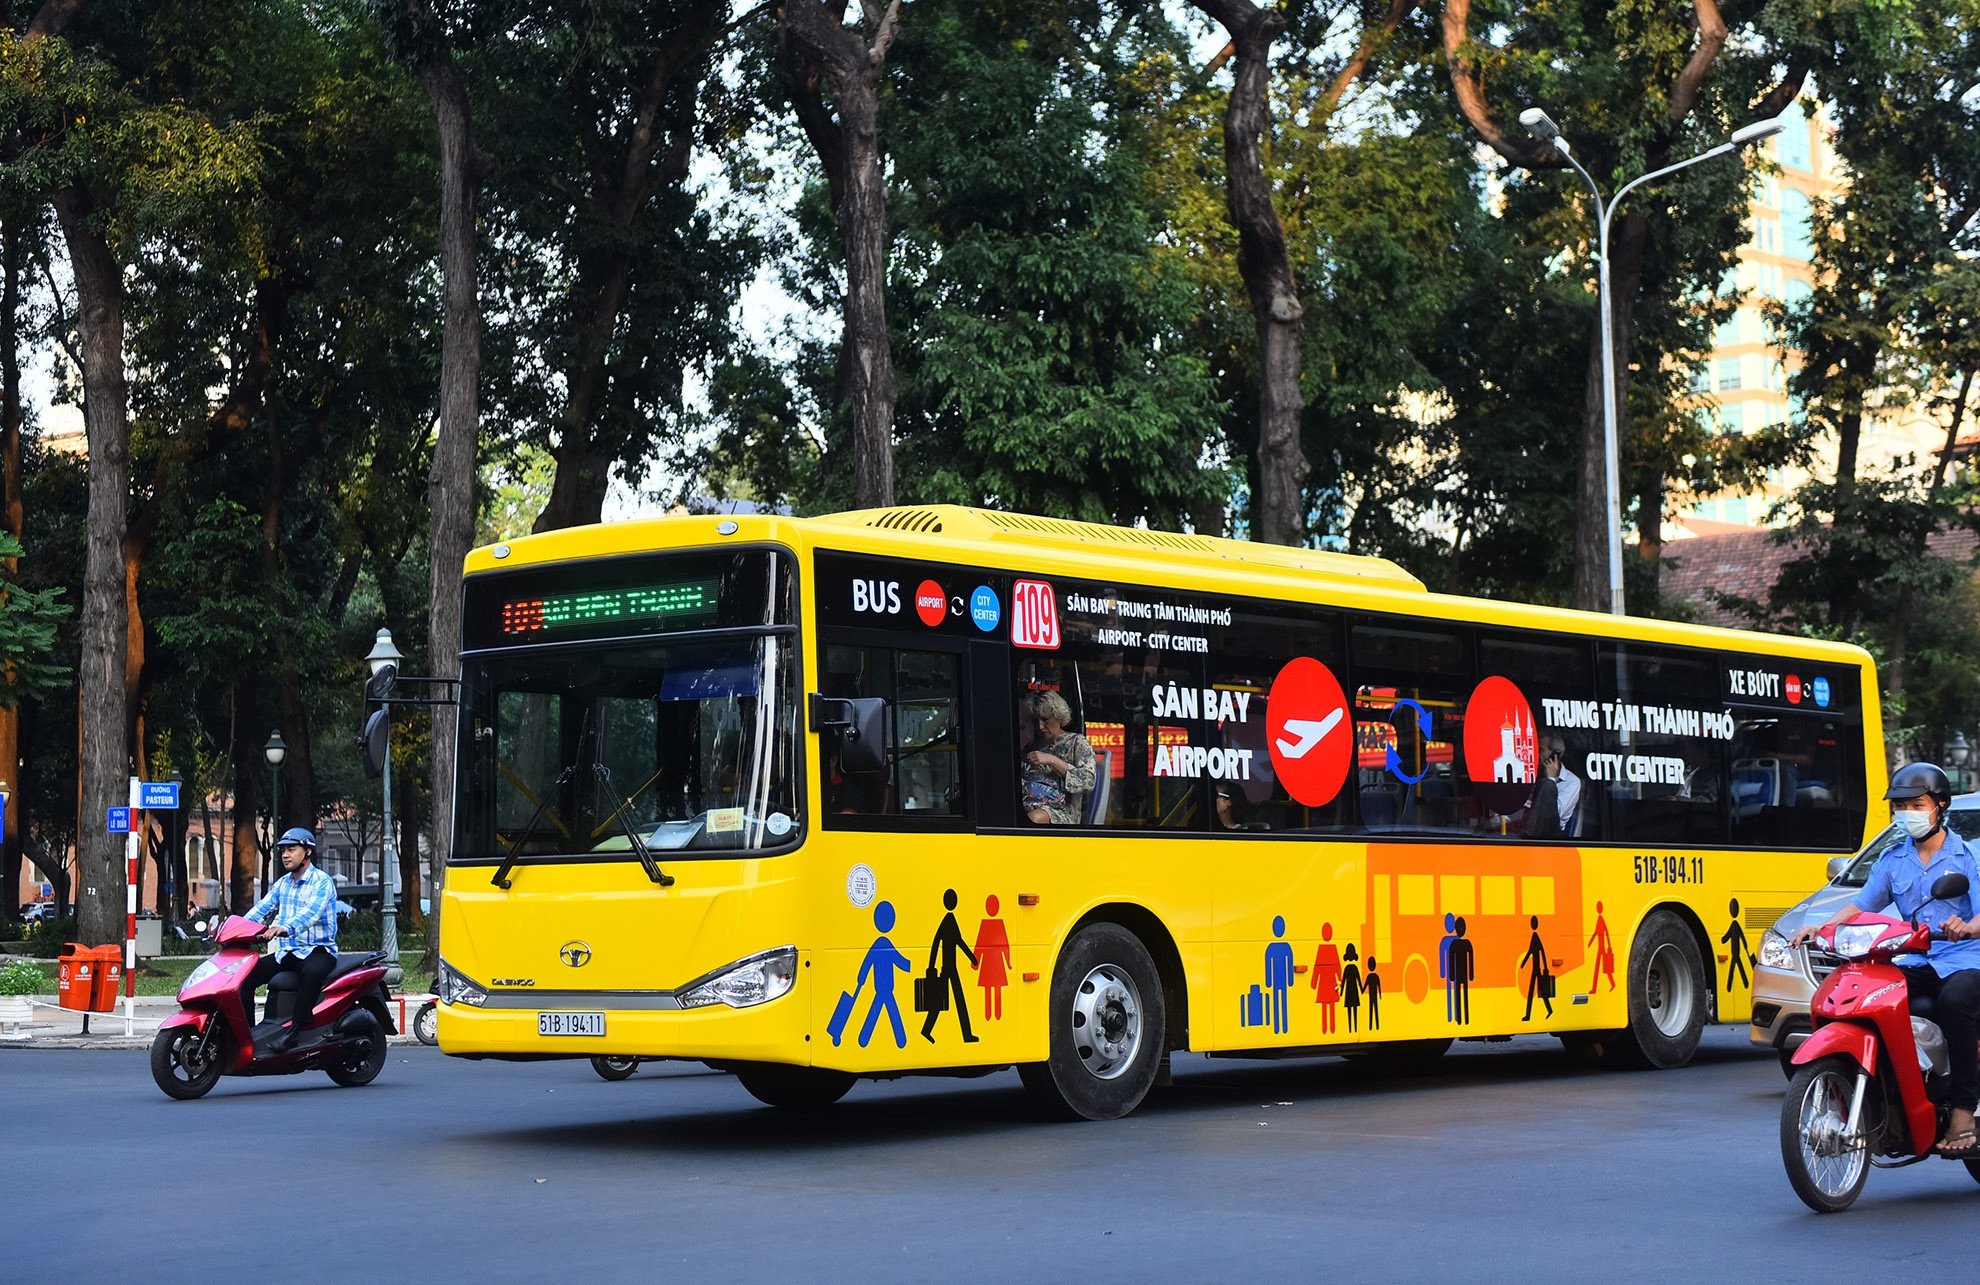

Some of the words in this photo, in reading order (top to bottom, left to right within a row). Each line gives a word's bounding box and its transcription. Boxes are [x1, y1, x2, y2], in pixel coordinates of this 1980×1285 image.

[852, 579, 901, 614] BUS
[918, 596, 944, 609] AIRPORT
[977, 595, 991, 607] CITY
[1066, 593, 1089, 613] SÂN
[1090, 597, 1110, 615] BAY
[1116, 600, 1151, 619] TRUNG
[1153, 602, 1175, 621] TÂM
[1175, 604, 1210, 624] THÀNH
[1211, 607, 1232, 627] PHỐ
[973, 608, 998, 622] CENTER
[1016, 584, 1051, 644] 109
[1098, 628, 1142, 648] AIRPORT
[1149, 633, 1171, 650] CITY
[1172, 635, 1209, 653] CENTER
[1729, 669, 1746, 695] XE
[1747, 669, 1780, 698] BÚYT
[1152, 680, 1198, 720] SÂN
[1203, 689, 1251, 723] BAY
[1542, 698, 1600, 729] TRUNG
[1601, 698, 1641, 732] TÂM
[1642, 704, 1700, 737] THÀNH
[1702, 708, 1735, 741] PHỐ
[1153, 744, 1253, 781] AIRPORT
[1586, 752, 1623, 782] CITY
[1625, 755, 1685, 785] CENTER
[145, 795, 174, 805] PASTEUR
[1634, 855, 1703, 884] 51B-194.11
[87, 887, 97, 896] 72
[492, 978, 535, 987] DAEWOO
[540, 1014, 601, 1033] 51B-194.11
